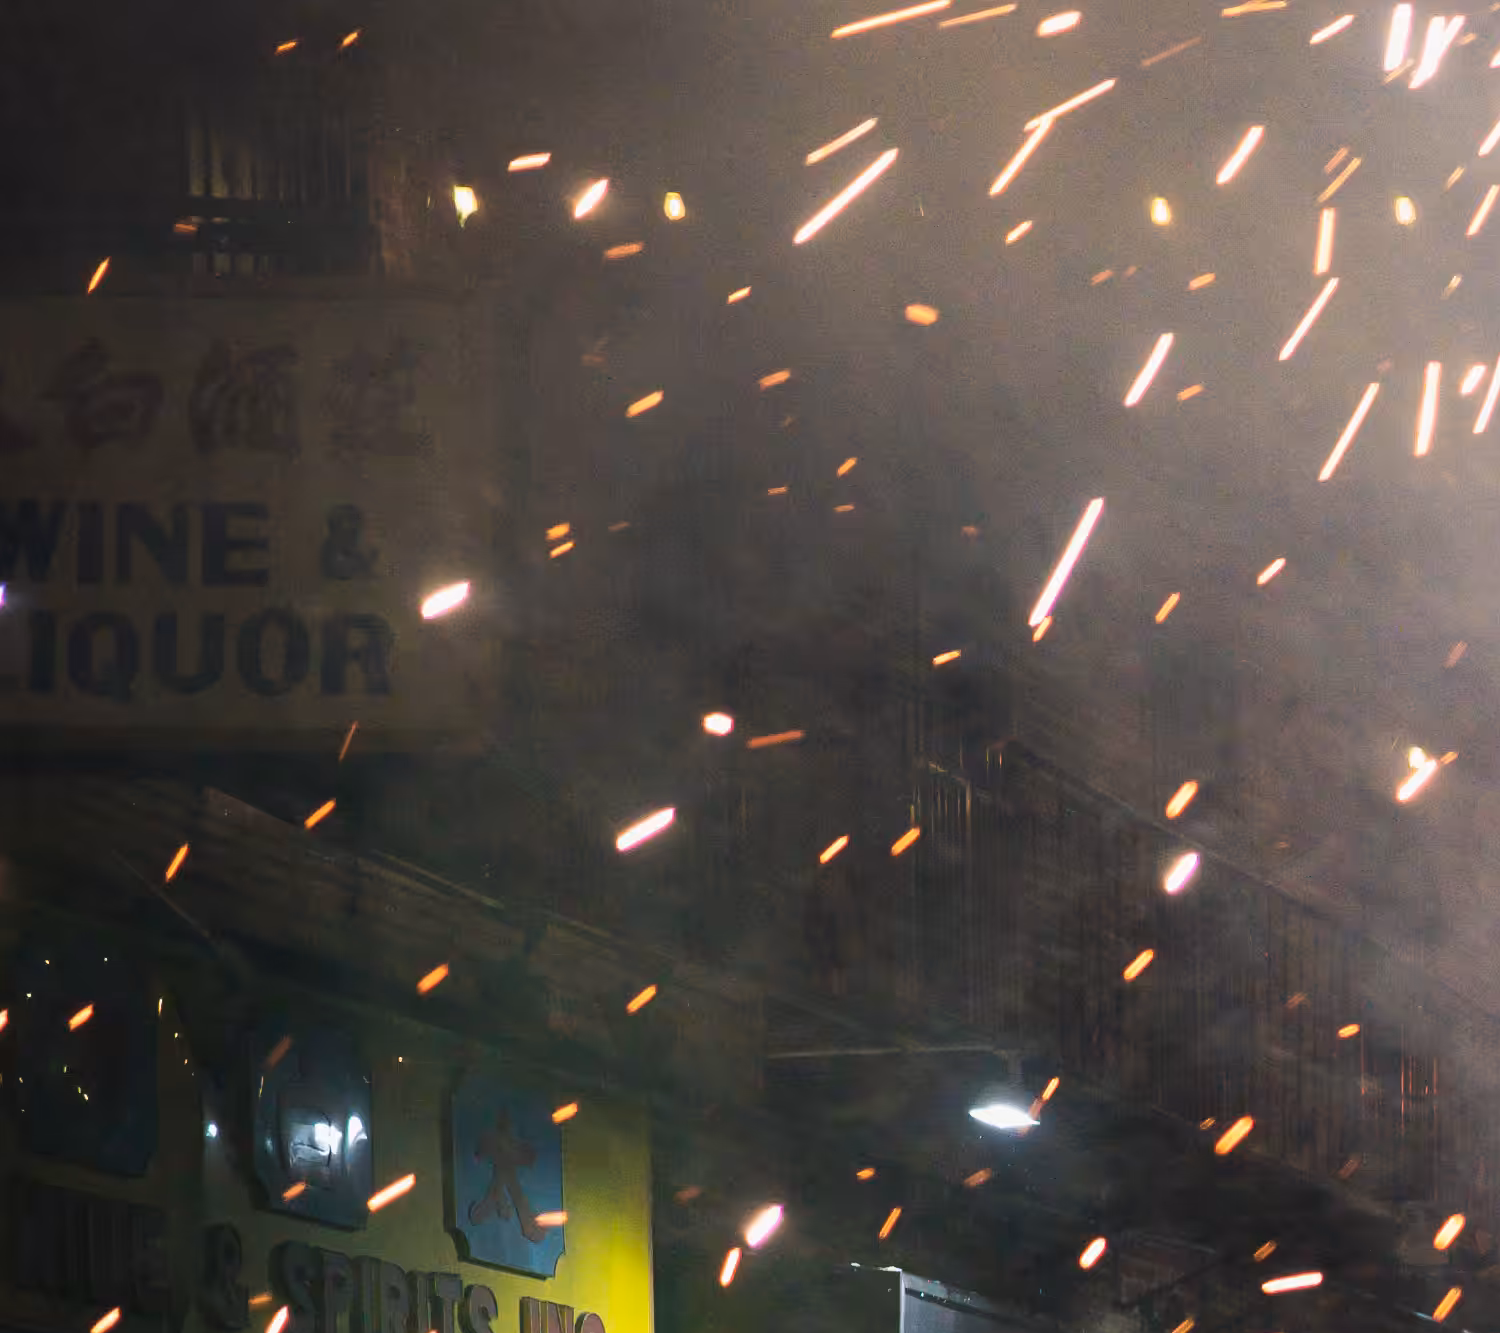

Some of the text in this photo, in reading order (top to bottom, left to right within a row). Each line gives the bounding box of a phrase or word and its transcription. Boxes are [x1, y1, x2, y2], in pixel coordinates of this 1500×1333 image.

[0, 499, 380, 587] WINE &
[0, 610, 393, 700] IQUOR
